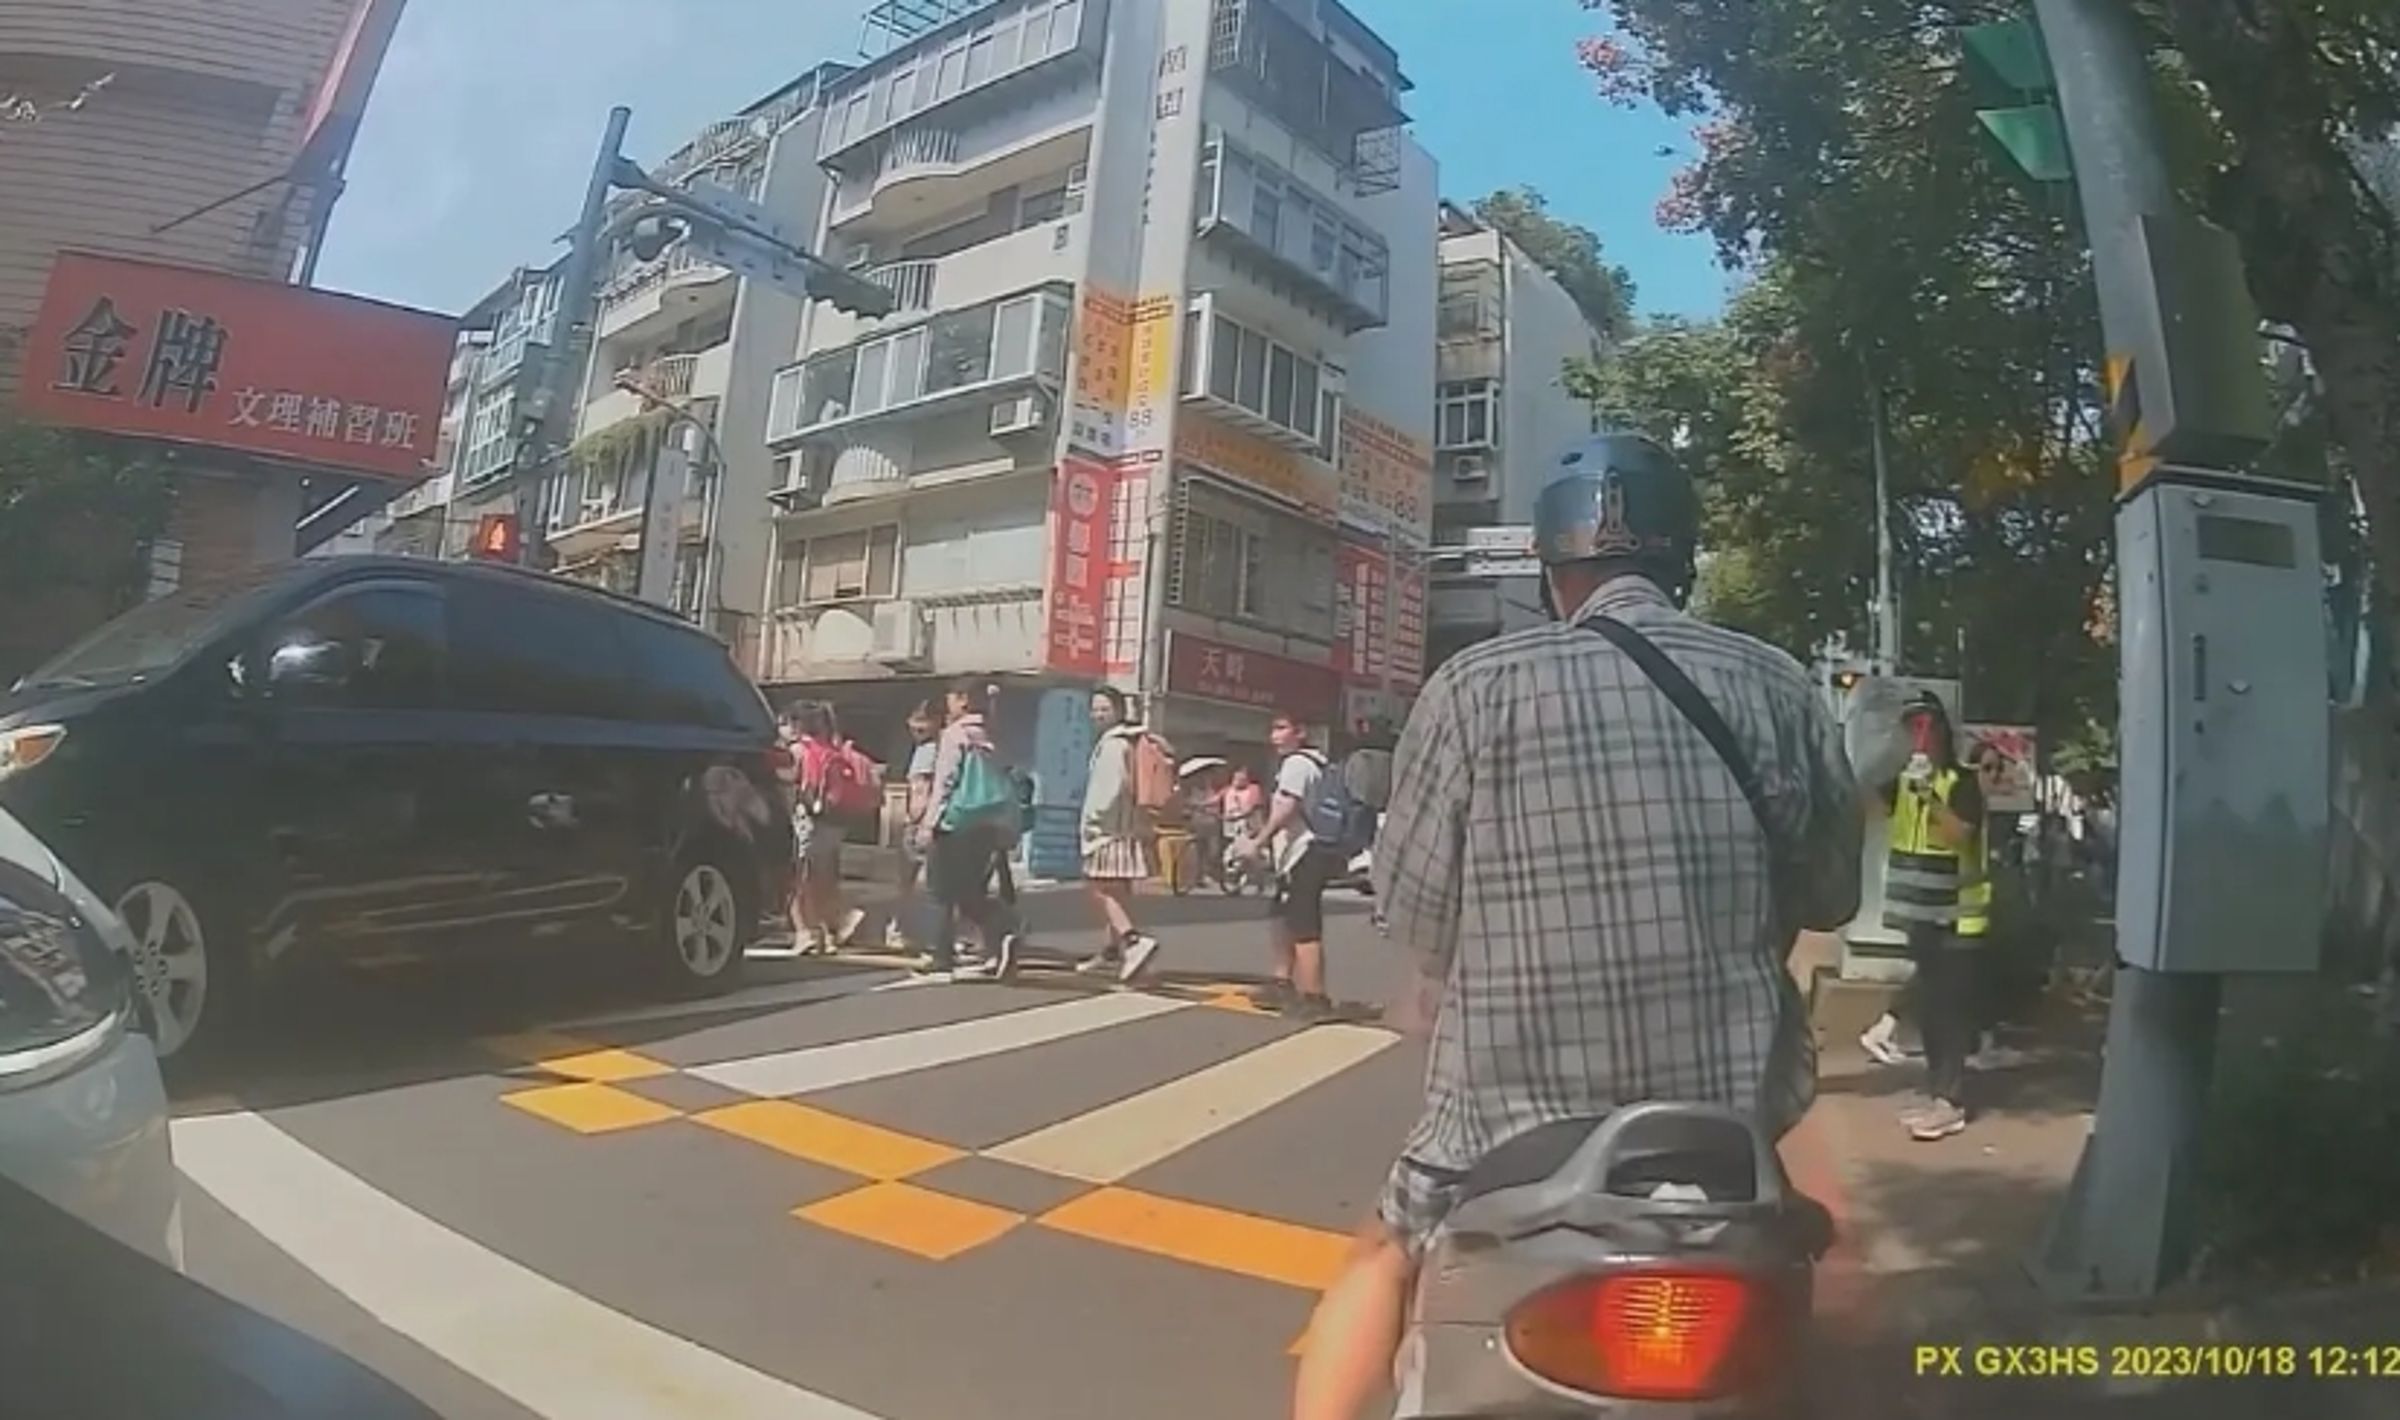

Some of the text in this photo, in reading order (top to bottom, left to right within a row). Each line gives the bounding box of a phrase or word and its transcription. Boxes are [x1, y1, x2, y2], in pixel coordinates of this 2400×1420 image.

[49, 295, 231, 415] 金牌
[227, 385, 420, 451] 文理補習班
